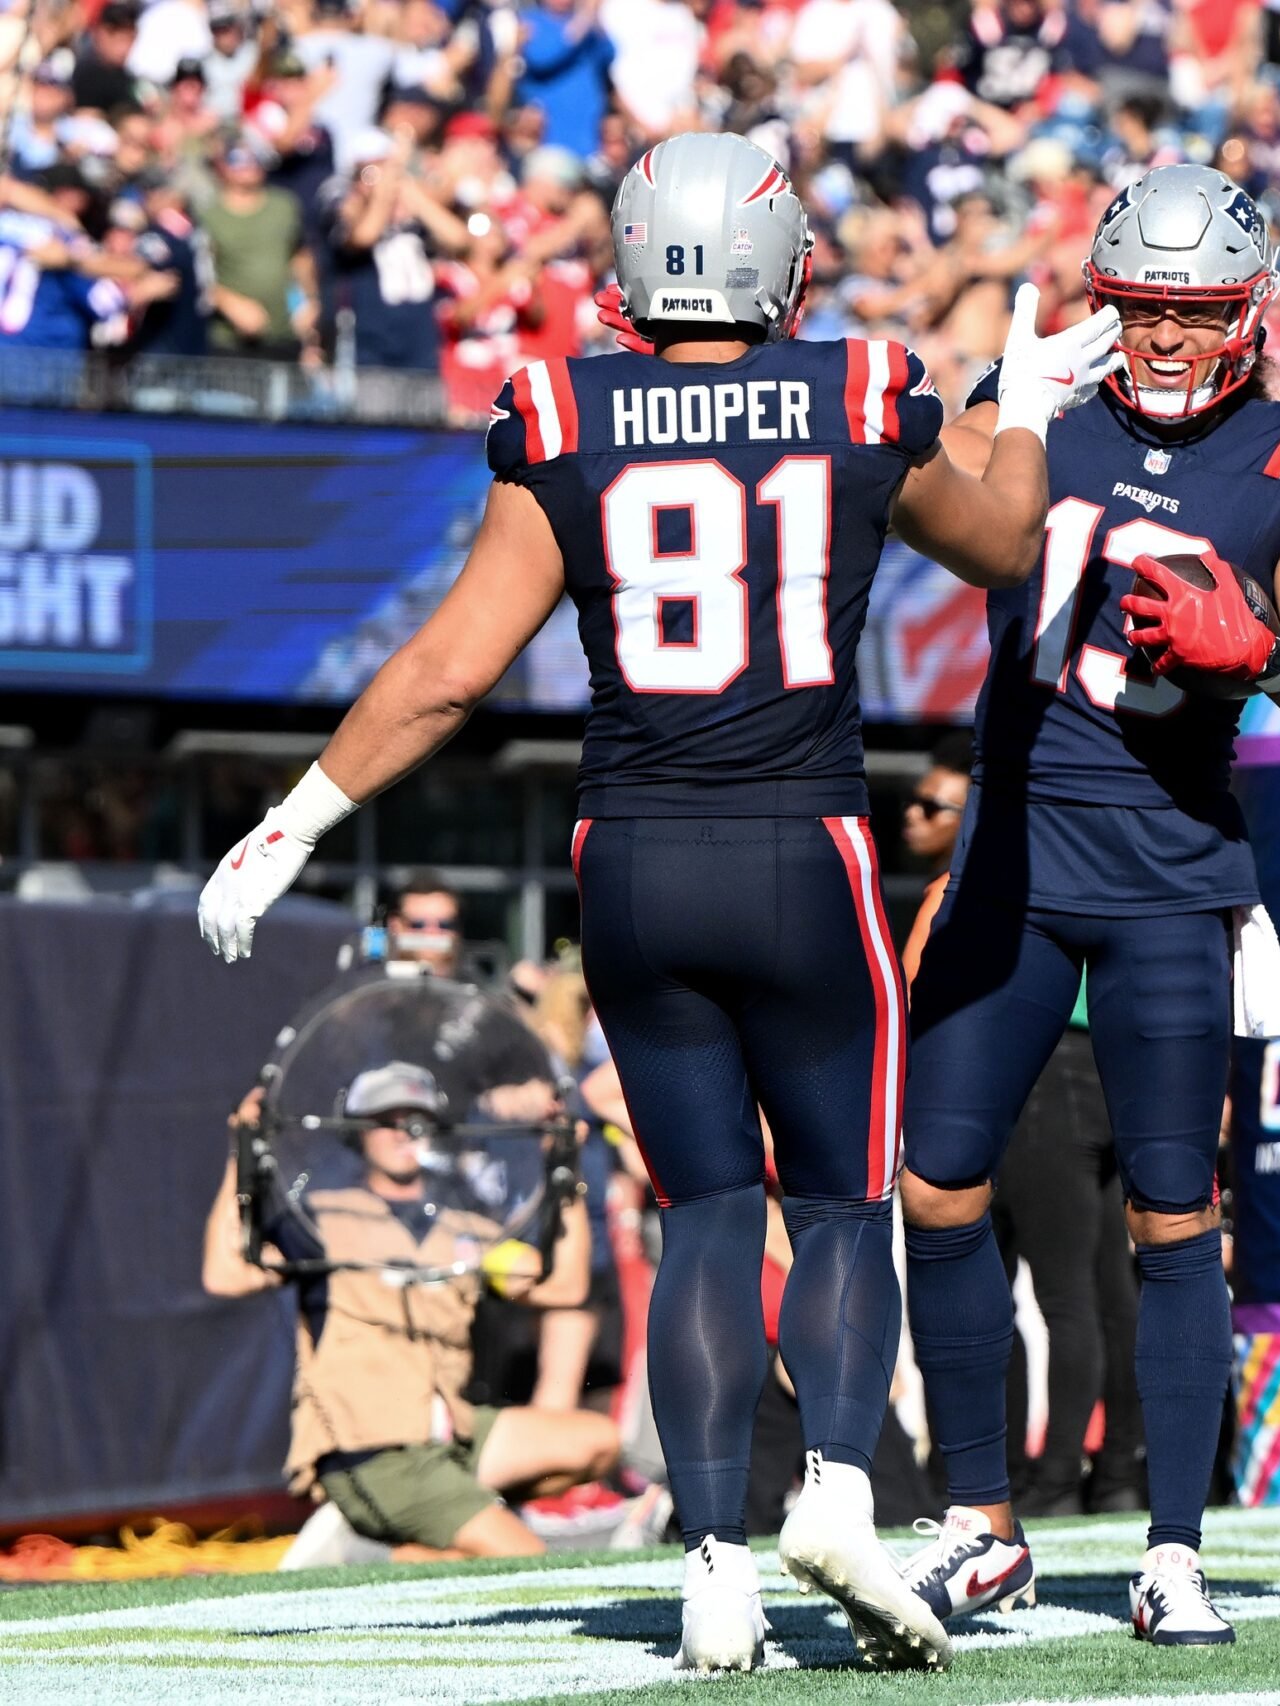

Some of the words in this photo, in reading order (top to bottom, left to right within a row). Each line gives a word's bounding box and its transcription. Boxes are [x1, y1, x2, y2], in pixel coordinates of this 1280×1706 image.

[666, 245, 704, 275] 81
[1145, 271, 1190, 284] PATRIOTS
[662, 297, 713, 313] PATRIOTS
[613, 381, 811, 446] HOOPER
[1147, 458, 1165, 471] NFL
[1112, 482, 1180, 514] PATRIOTS
[601, 455, 835, 694] 81
[951, 1515, 972, 1531] THE
